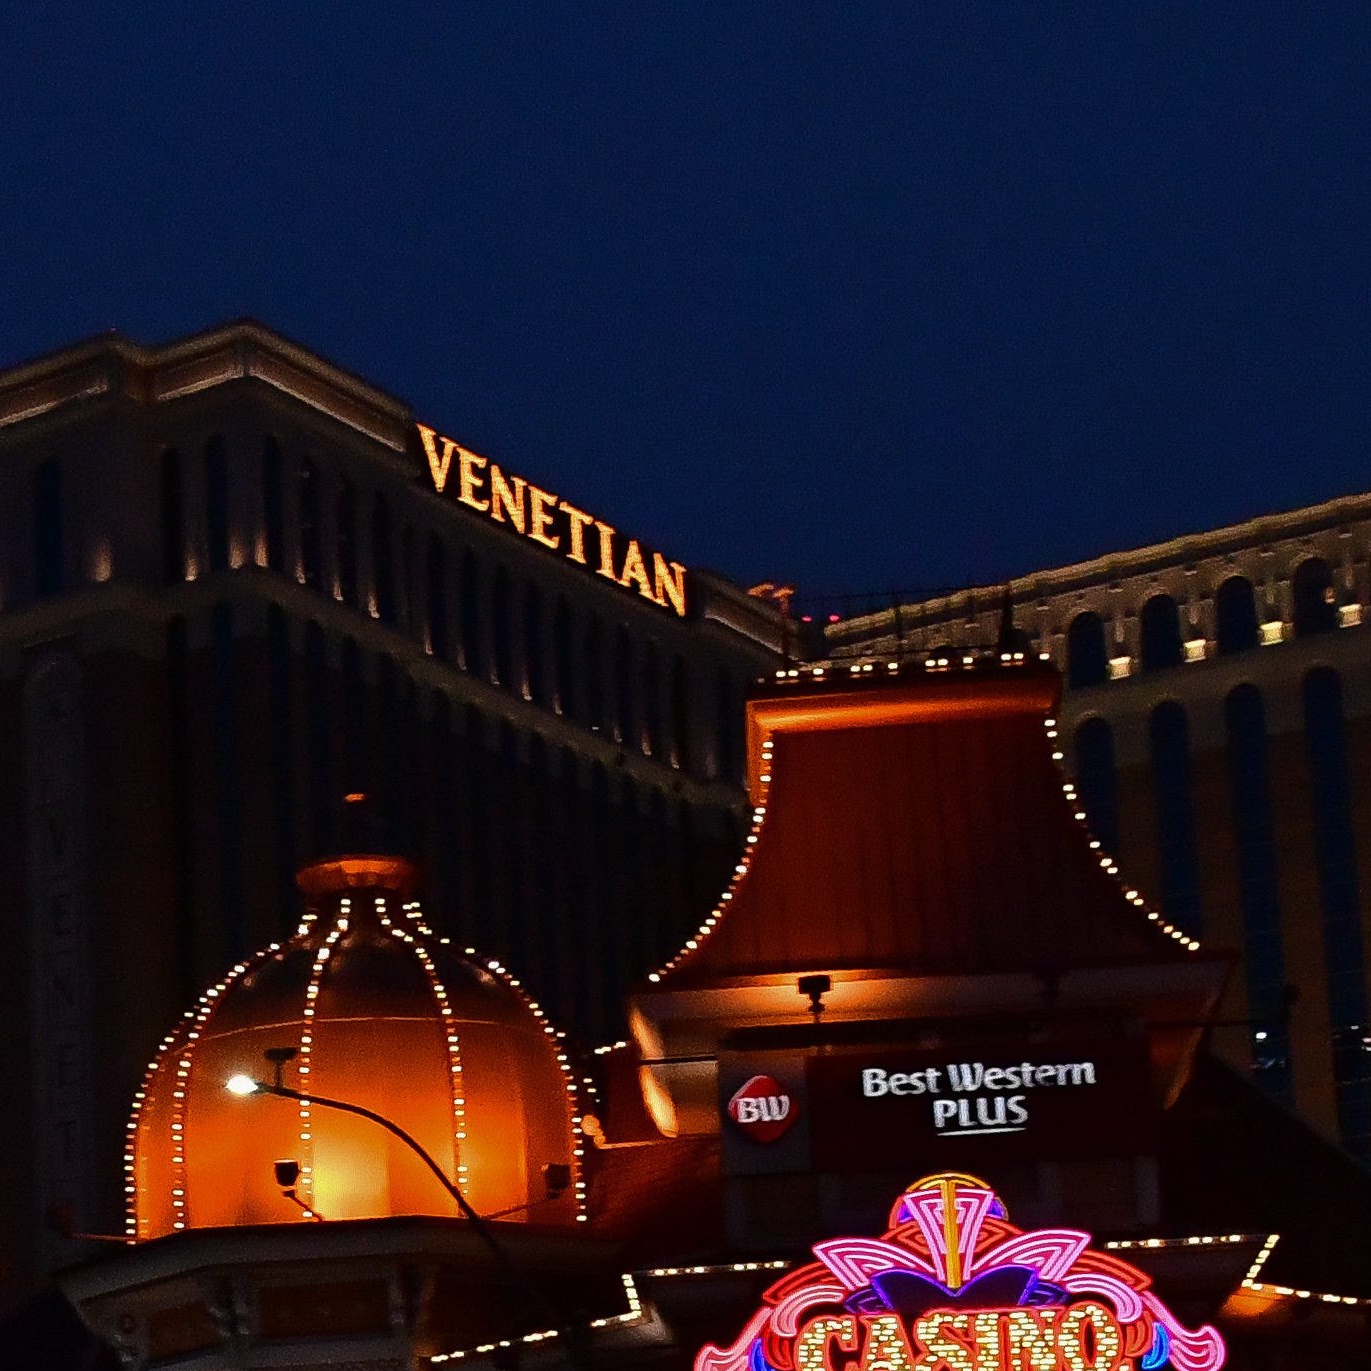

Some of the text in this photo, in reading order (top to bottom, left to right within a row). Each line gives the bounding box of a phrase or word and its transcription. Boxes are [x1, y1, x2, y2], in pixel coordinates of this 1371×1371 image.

[416, 423, 687, 617] VENETIAN
[862, 1062, 1096, 1097] Best Western
[737, 1096, 791, 1123] BW
[933, 1095, 1029, 1128] PLUS
